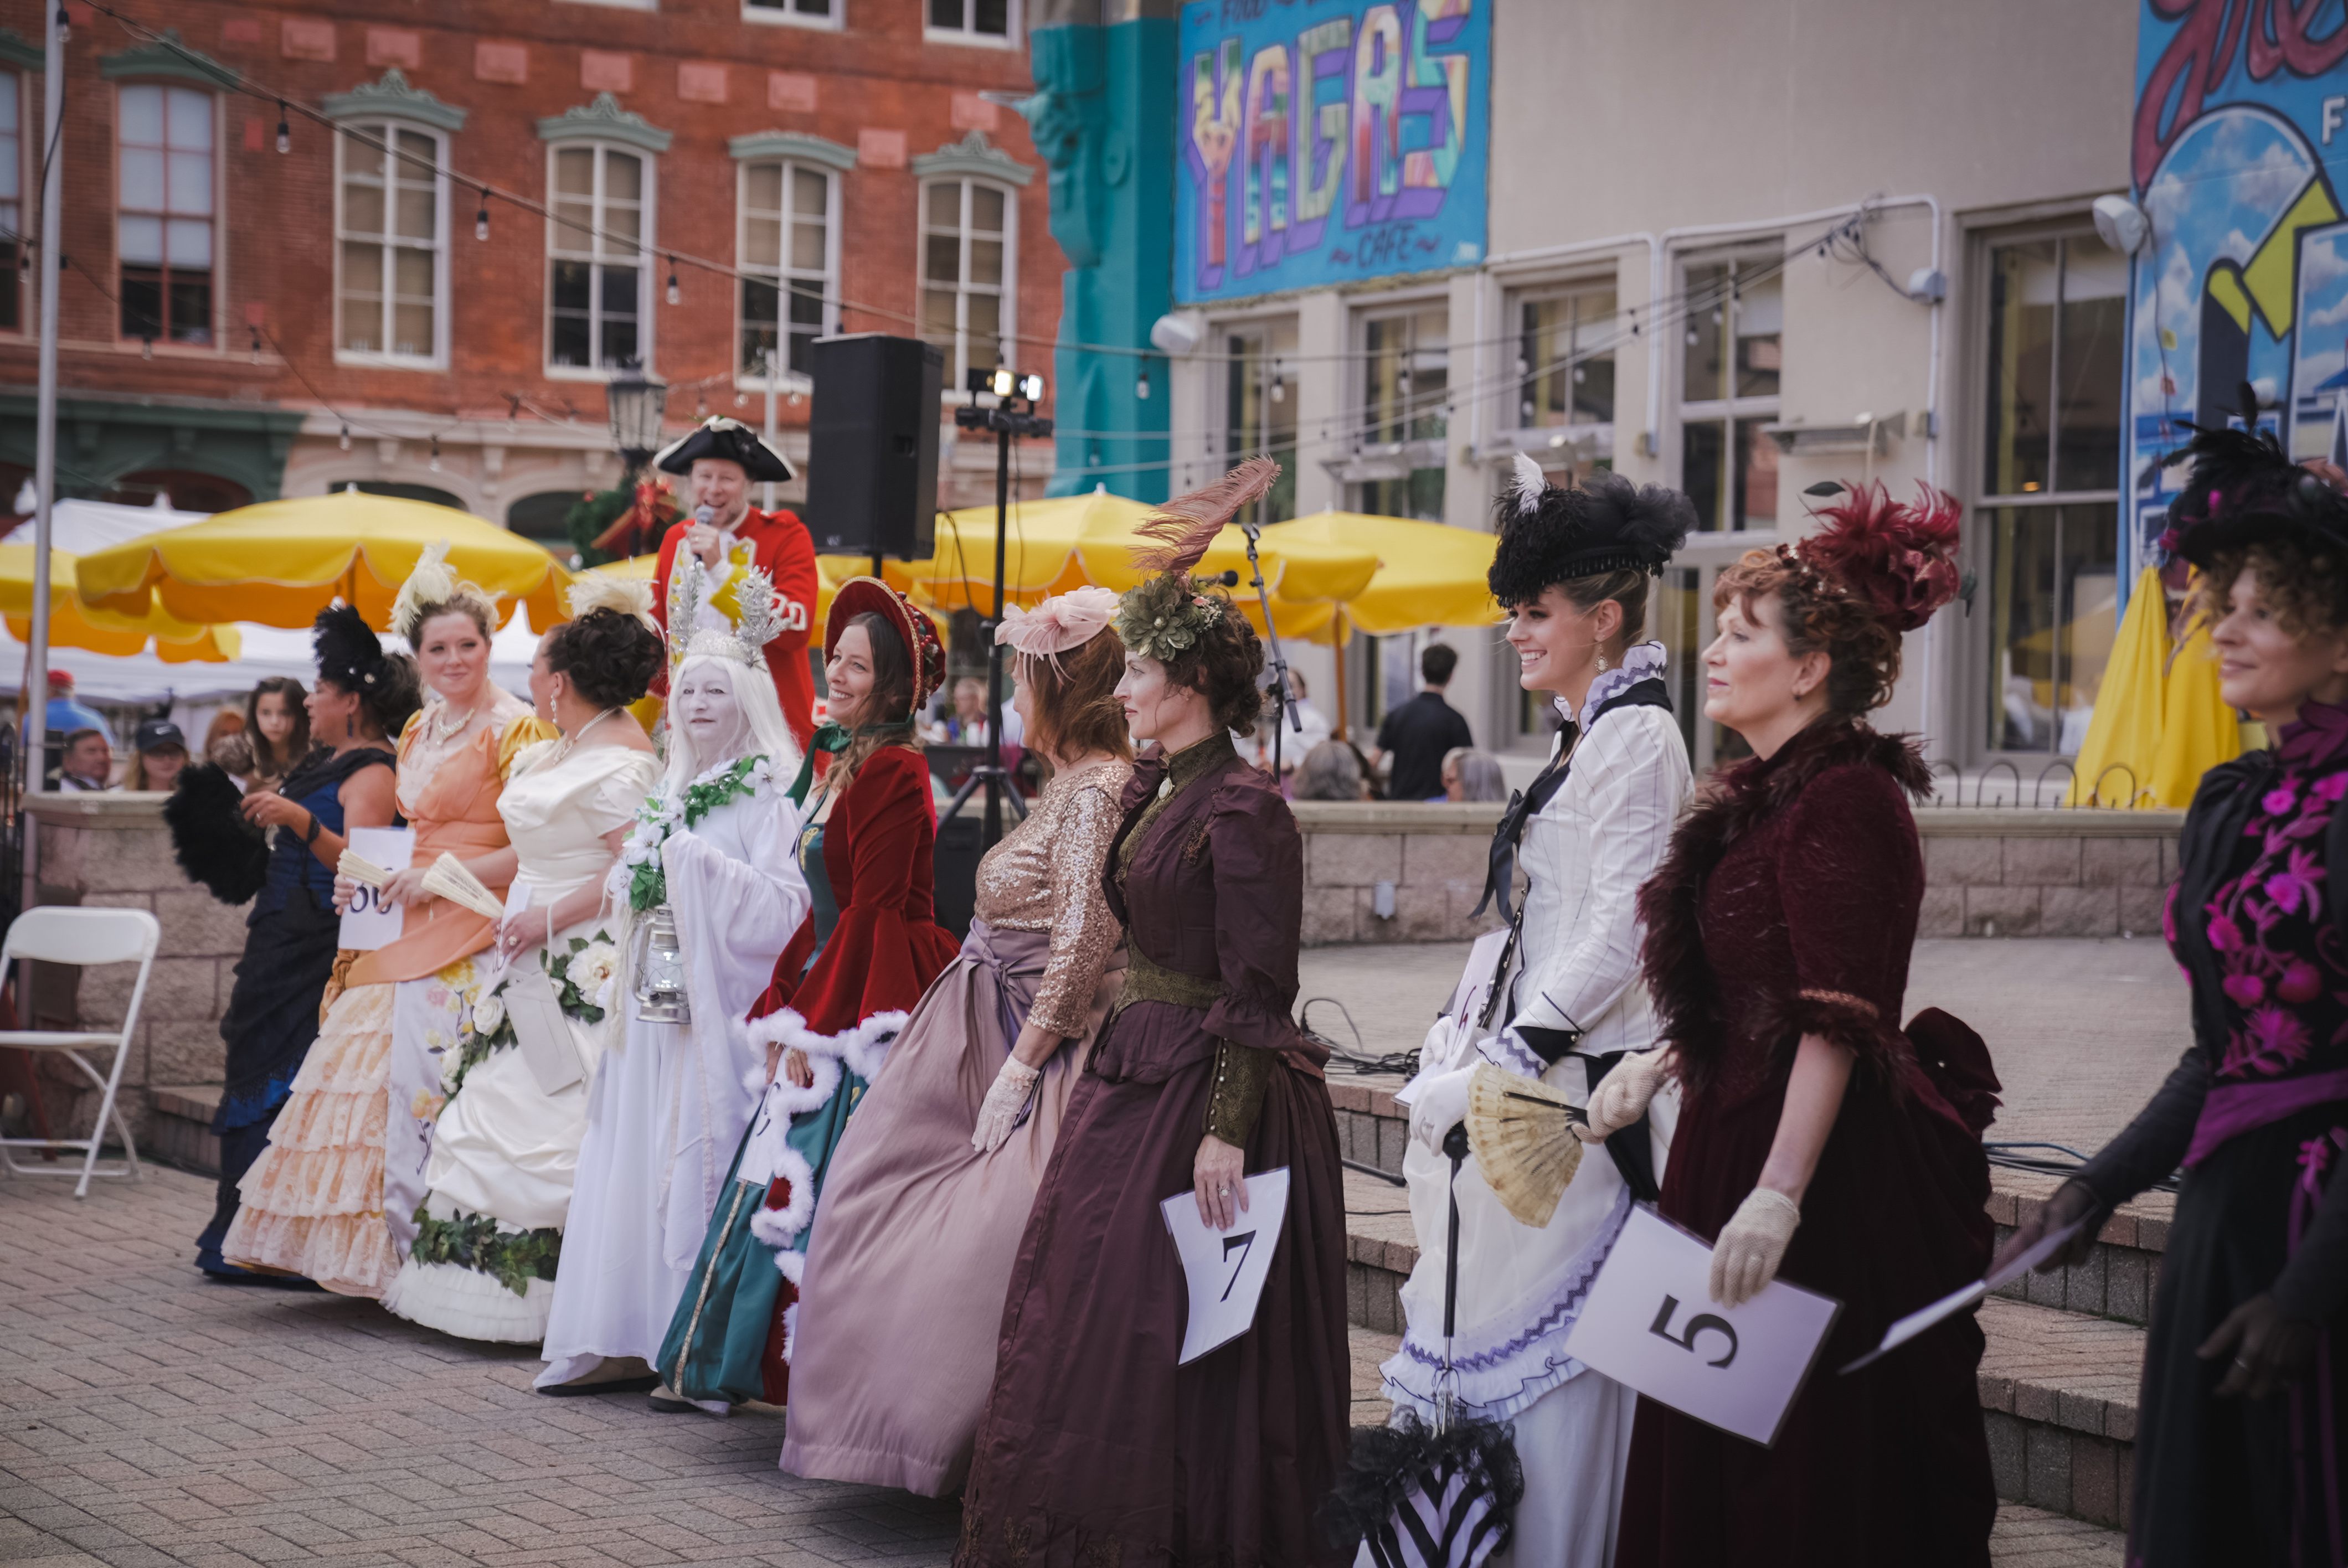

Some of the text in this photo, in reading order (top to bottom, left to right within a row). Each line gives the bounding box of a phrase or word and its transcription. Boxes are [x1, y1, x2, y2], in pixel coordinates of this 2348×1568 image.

[1358, 223, 1417, 268] CAFE
[1220, 1229, 1256, 1303] 7
[1648, 1293, 1738, 1370] 5
